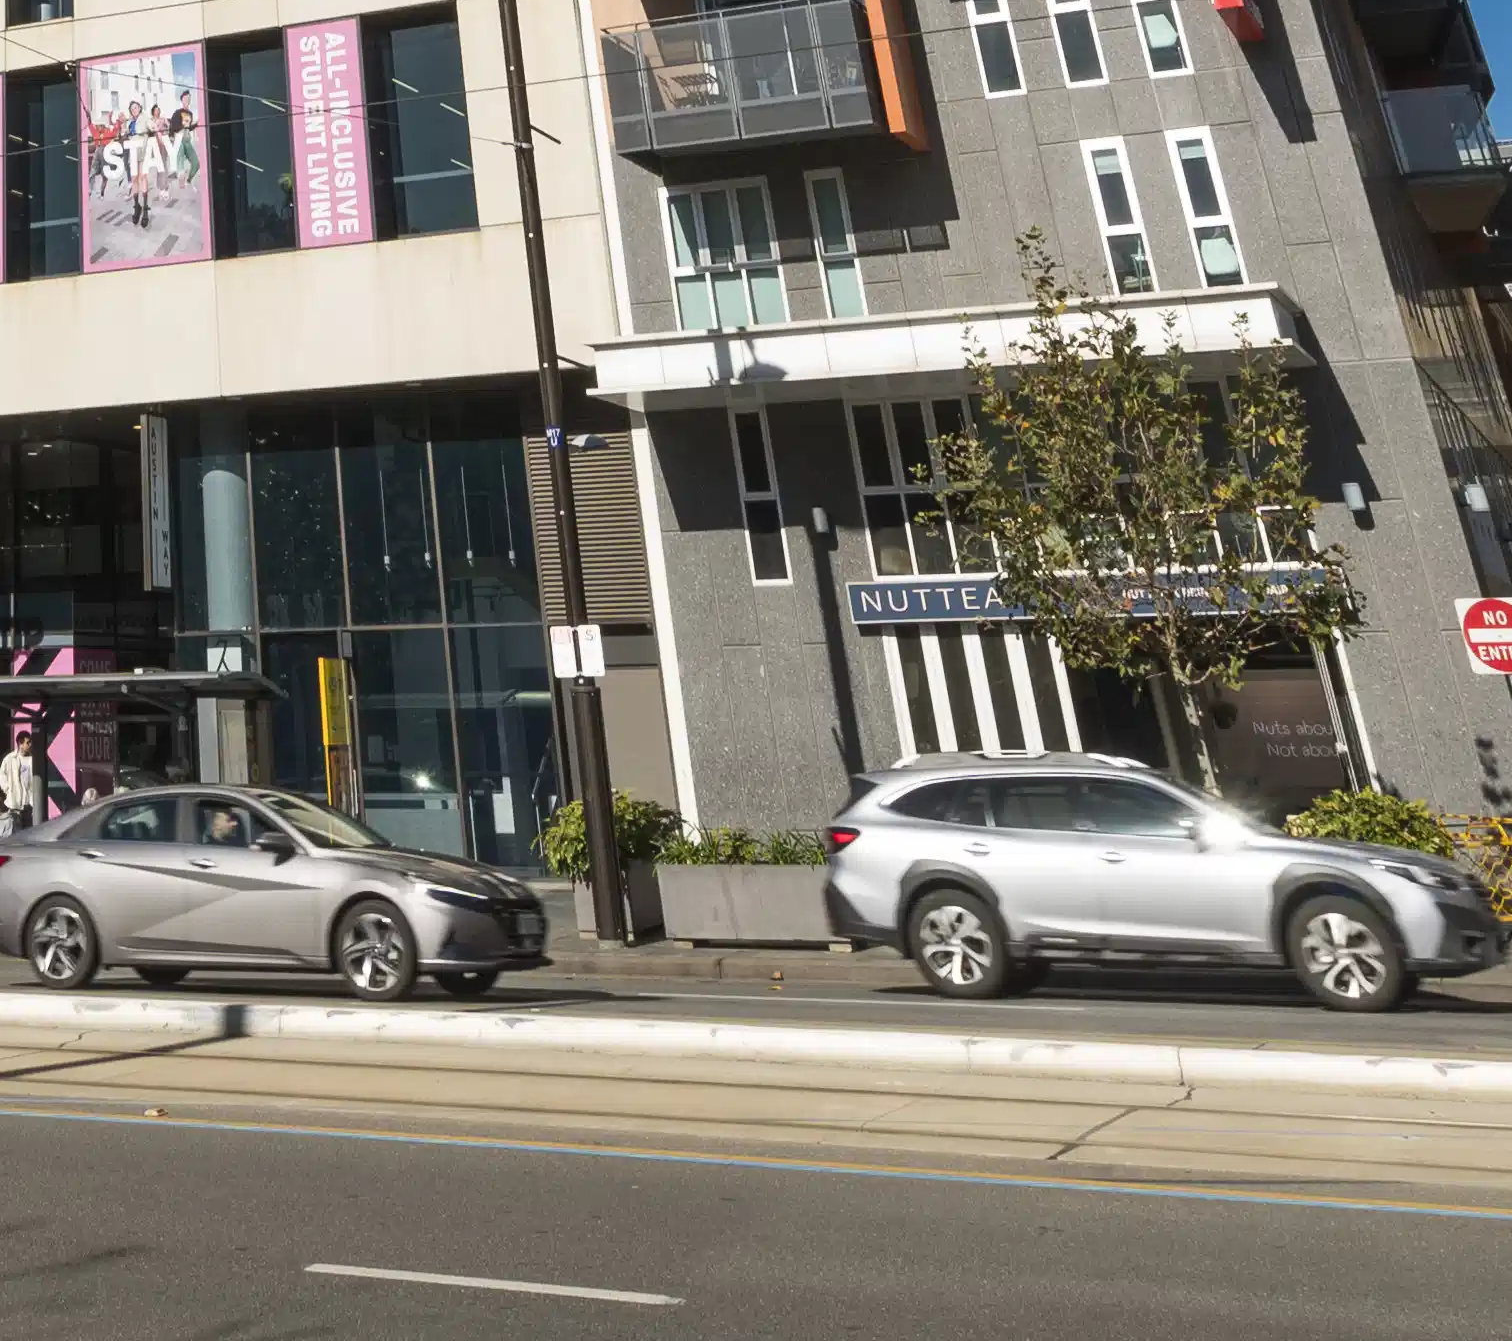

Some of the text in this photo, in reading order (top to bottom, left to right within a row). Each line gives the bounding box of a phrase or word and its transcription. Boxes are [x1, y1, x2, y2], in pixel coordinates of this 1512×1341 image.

[299, 35, 333, 239] STUDENT LIVING
[323, 32, 361, 234] ALL-INCLUSIVE
[102, 132, 186, 180] STAY
[551, 434, 557, 446] U
[860, 588, 1004, 614] NUTTEA
[1482, 610, 1508, 626] NO
[1253, 721, 1334, 736] Nuts abou
[80, 737, 112, 761] TOUR
[1267, 743, 1340, 759] Not abou
